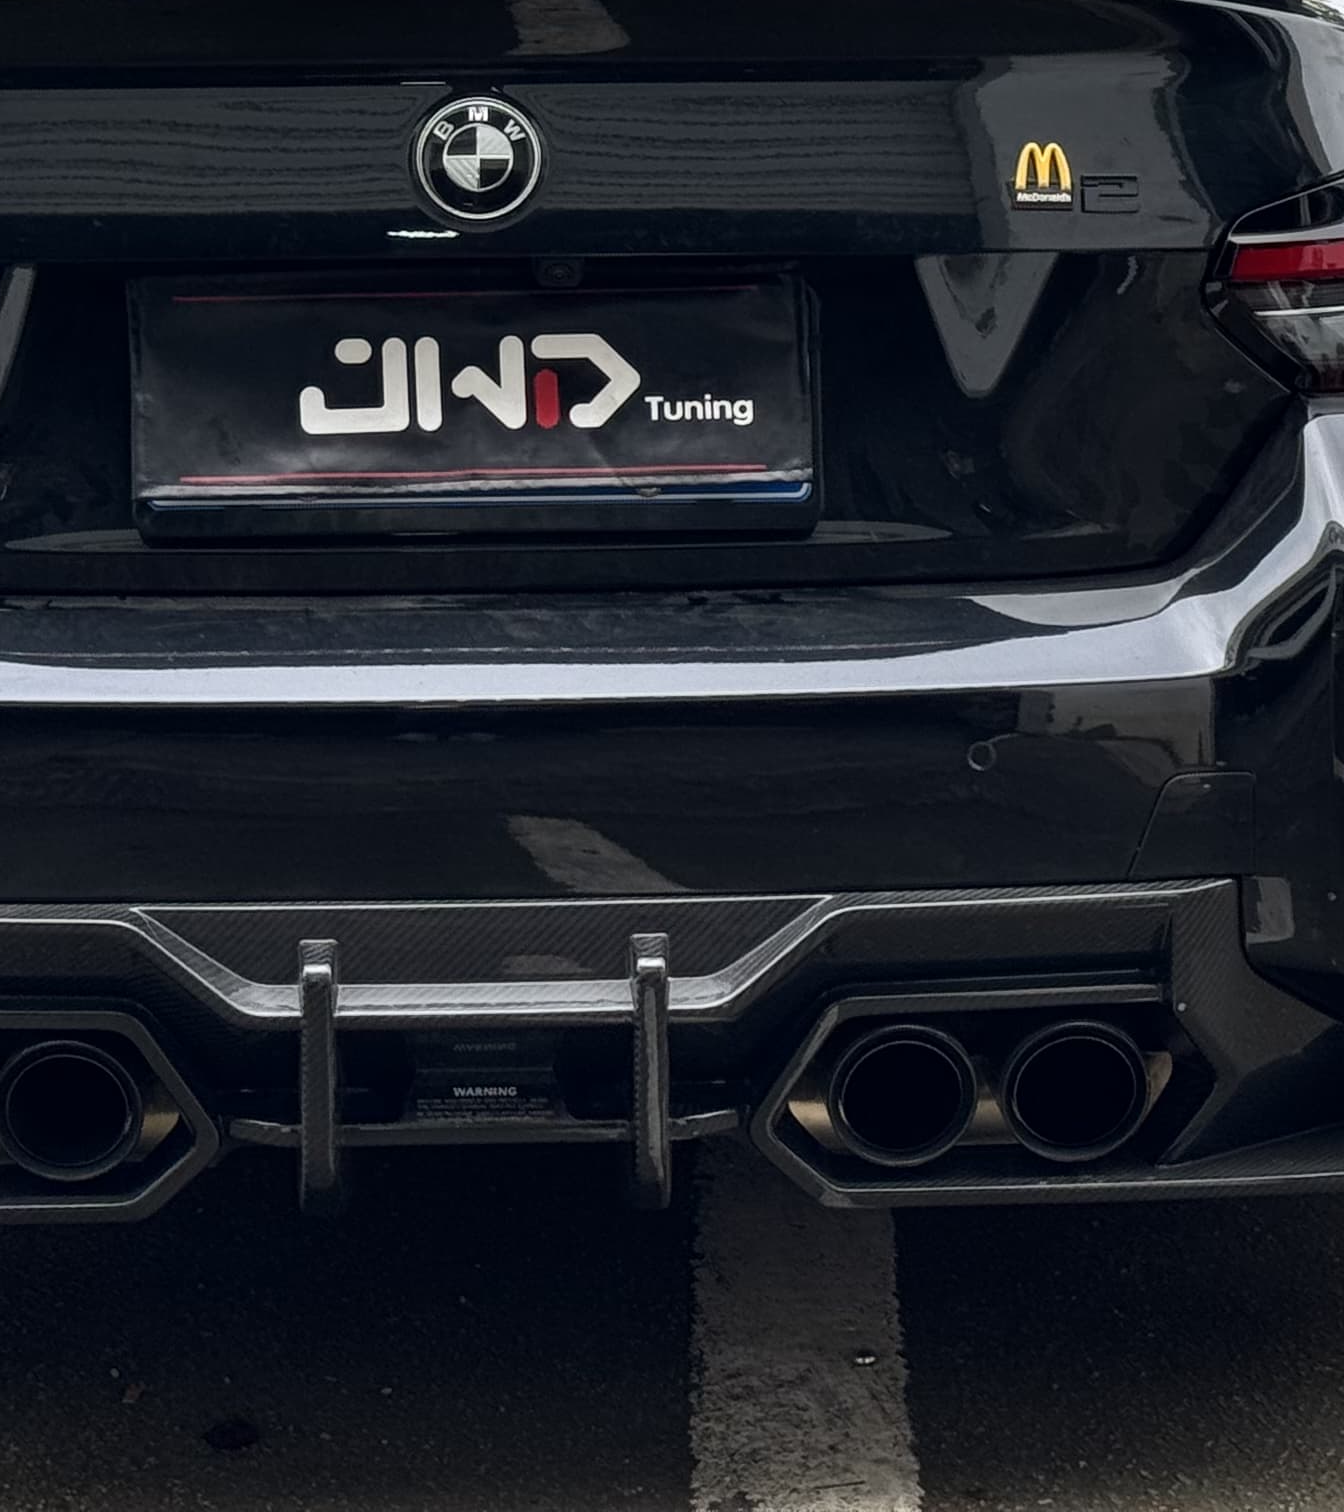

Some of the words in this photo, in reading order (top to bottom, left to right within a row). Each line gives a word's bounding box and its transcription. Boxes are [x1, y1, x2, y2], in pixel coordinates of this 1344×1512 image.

[432, 106, 526, 142] BMW
[644, 393, 754, 426] Tuning
[452, 1087, 518, 1097] WARNING
